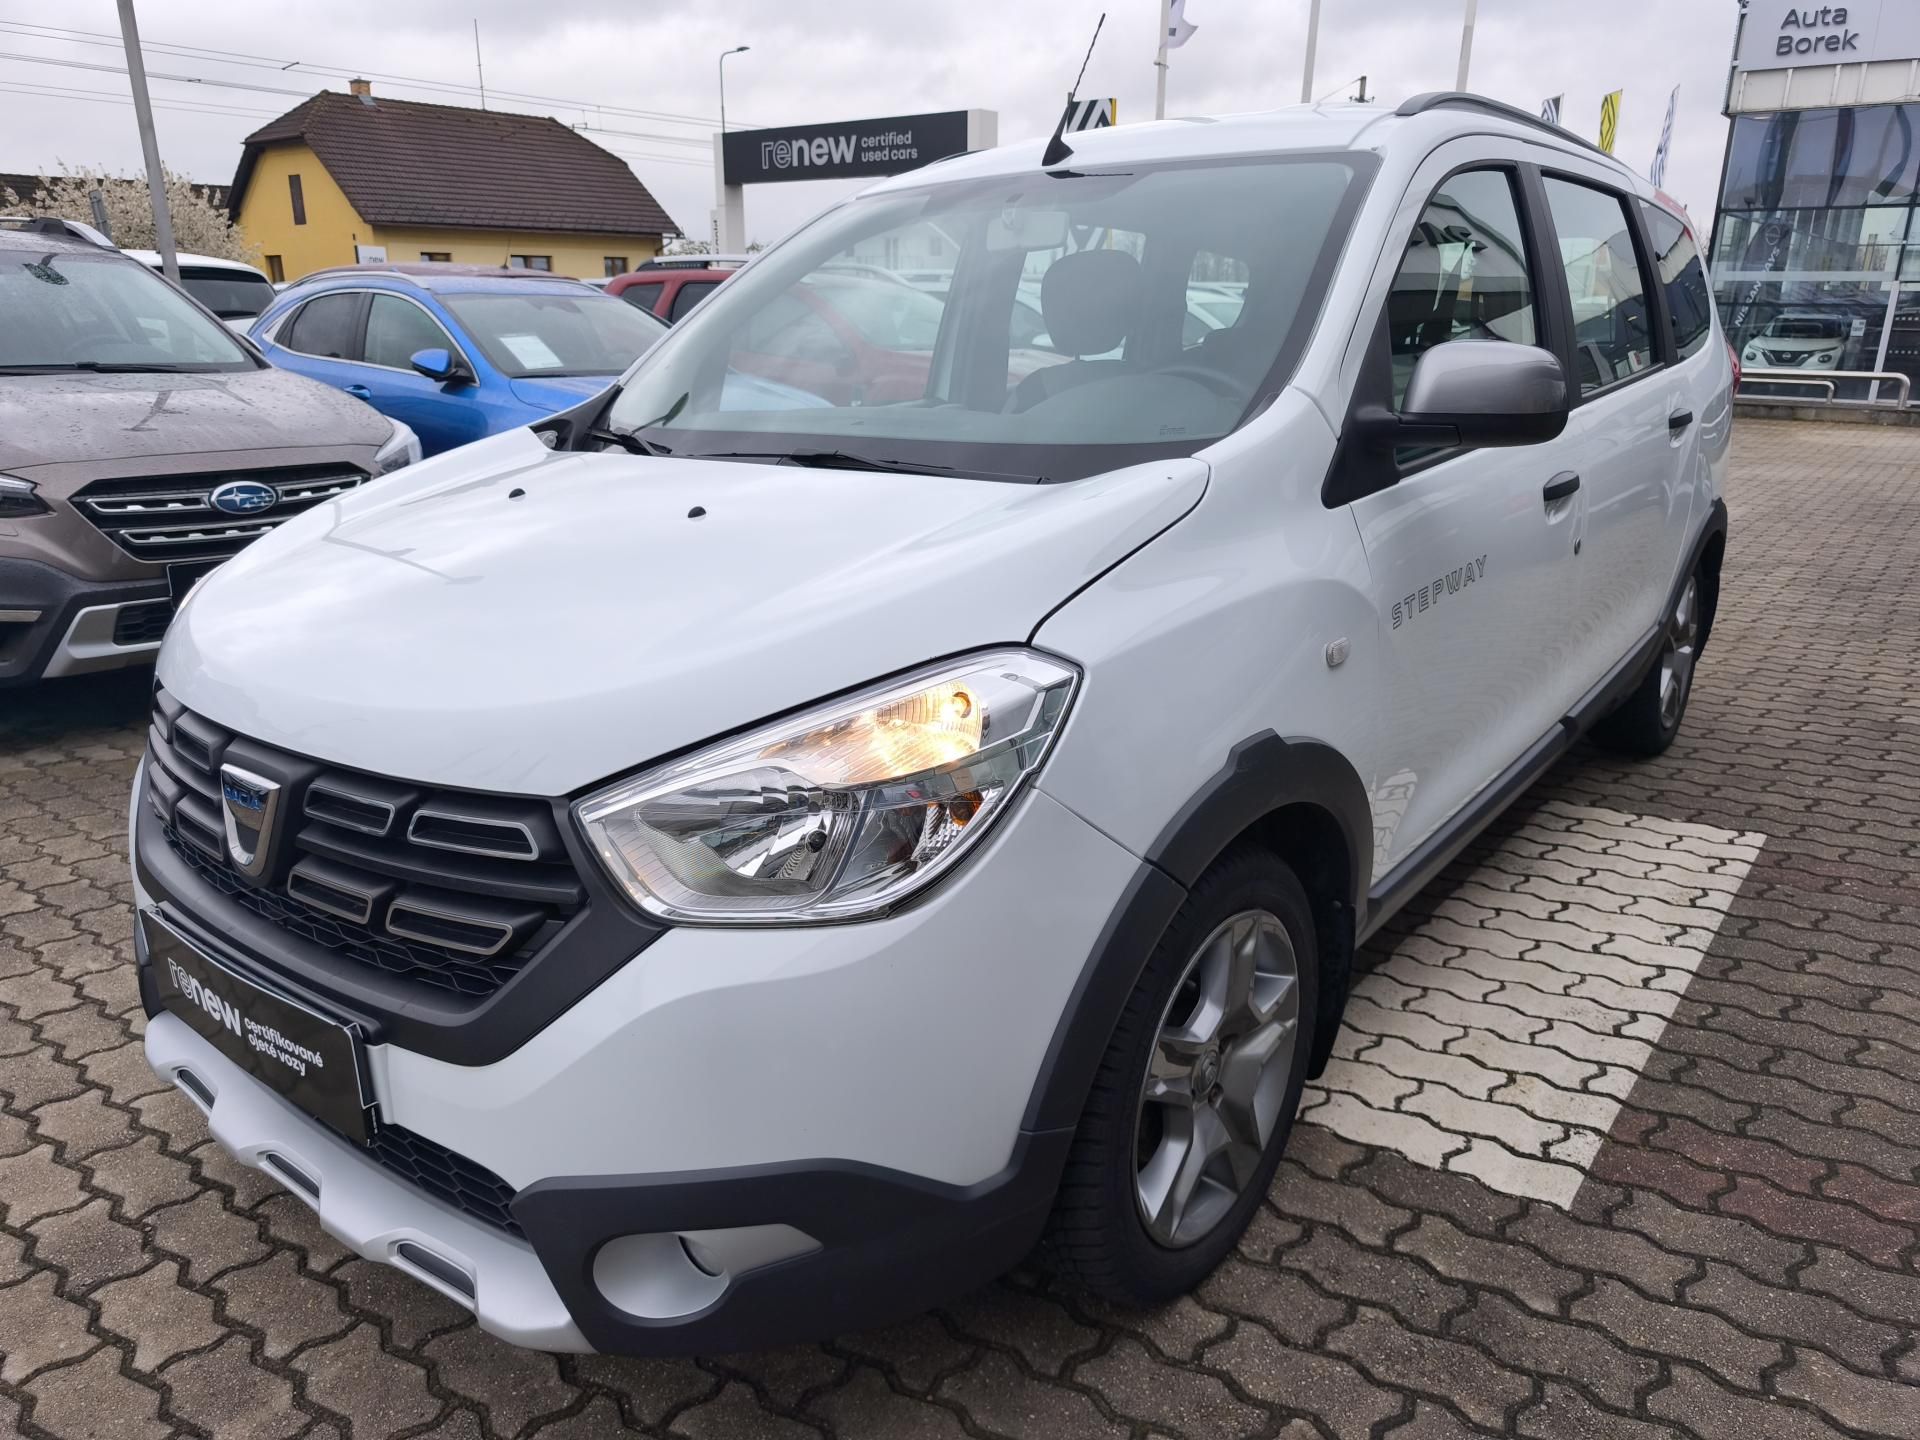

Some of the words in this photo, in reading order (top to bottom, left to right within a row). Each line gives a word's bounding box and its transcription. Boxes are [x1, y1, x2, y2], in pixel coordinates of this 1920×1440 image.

[1781, 5, 1848, 30] Auta
[1776, 28, 1860, 57] Borek
[761, 134, 857, 170] renew
[861, 130, 912, 148] certified
[861, 147, 890, 163] used
[891, 147, 918, 160] cars
[1391, 554, 1488, 631] STEPWAY
[167, 956, 243, 1038] renew
[244, 1016, 325, 1069] certifikované
[247, 1032, 279, 1060] ojeté
[277, 1048, 307, 1078] vozy
